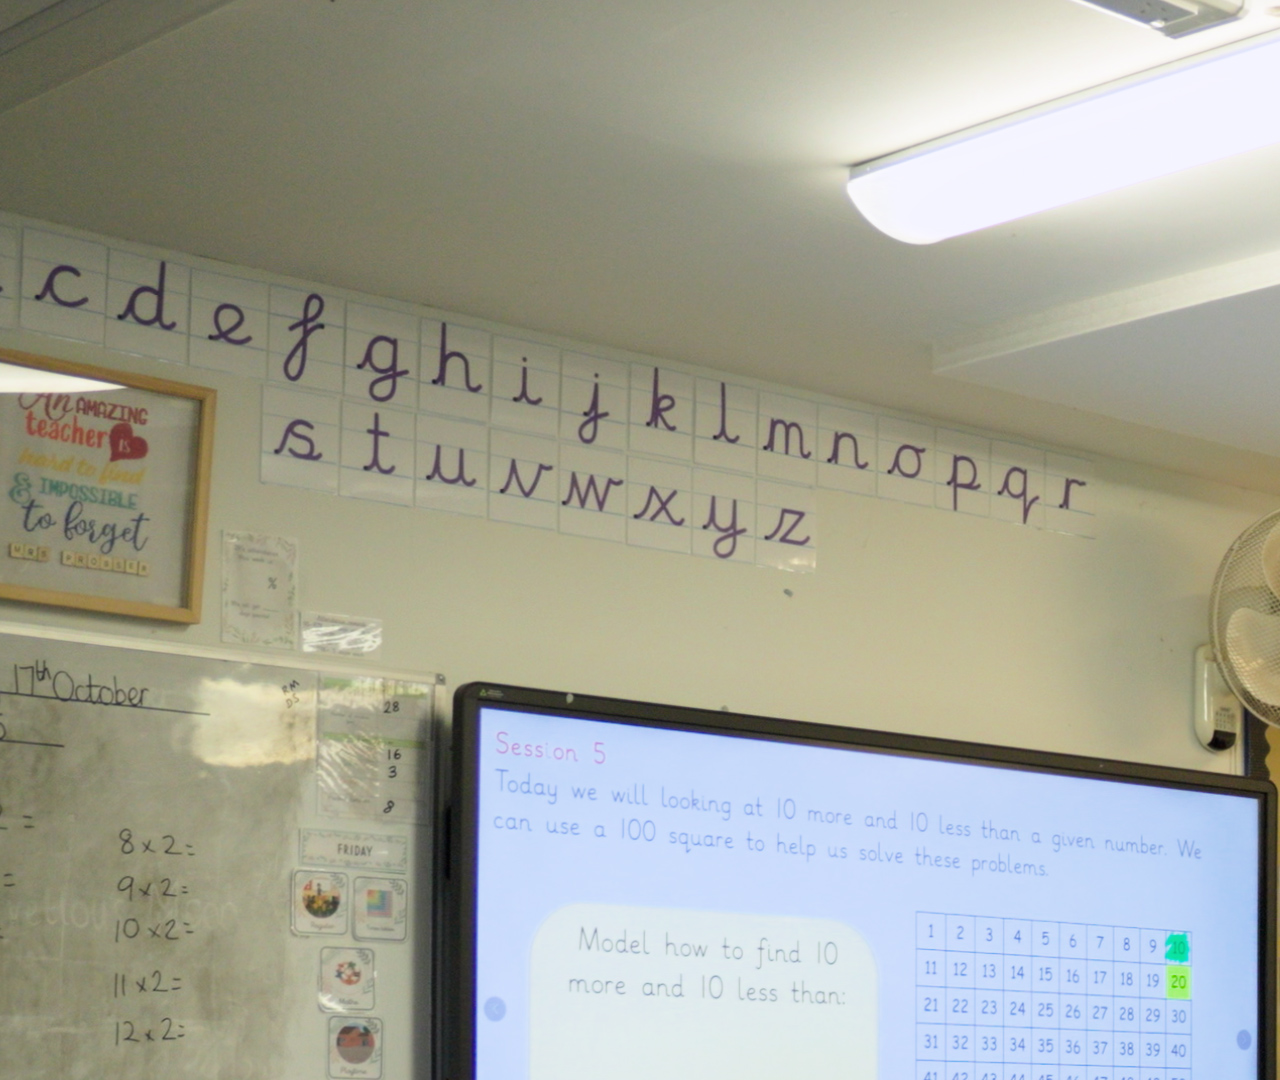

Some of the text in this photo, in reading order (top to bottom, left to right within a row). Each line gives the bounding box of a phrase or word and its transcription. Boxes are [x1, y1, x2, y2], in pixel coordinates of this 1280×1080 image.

[76, 396, 149, 426] AMAZING
[25, 409, 108, 449] teacher
[39, 476, 139, 511] IMPOSSIBLE
[22, 499, 151, 555] to forget
[13, 545, 148, 573] MRS PROSSER
[53, 671, 149, 707] October
[496, 731, 606, 765] Session 5
[495, 768, 1202, 860] Today we will looking at 10 more and 10 less than a given number. We
[337, 842, 373, 857] FRIDAY
[493, 814, 1049, 877] can use a 100 square to help us solve these problems.
[579, 926, 839, 970] Model how to find 10
[568, 973, 846, 1005] more and 10 less than:
[1010, 966, 1187, 990] 14 20
[1037, 1039, 1054, 1055] 35
